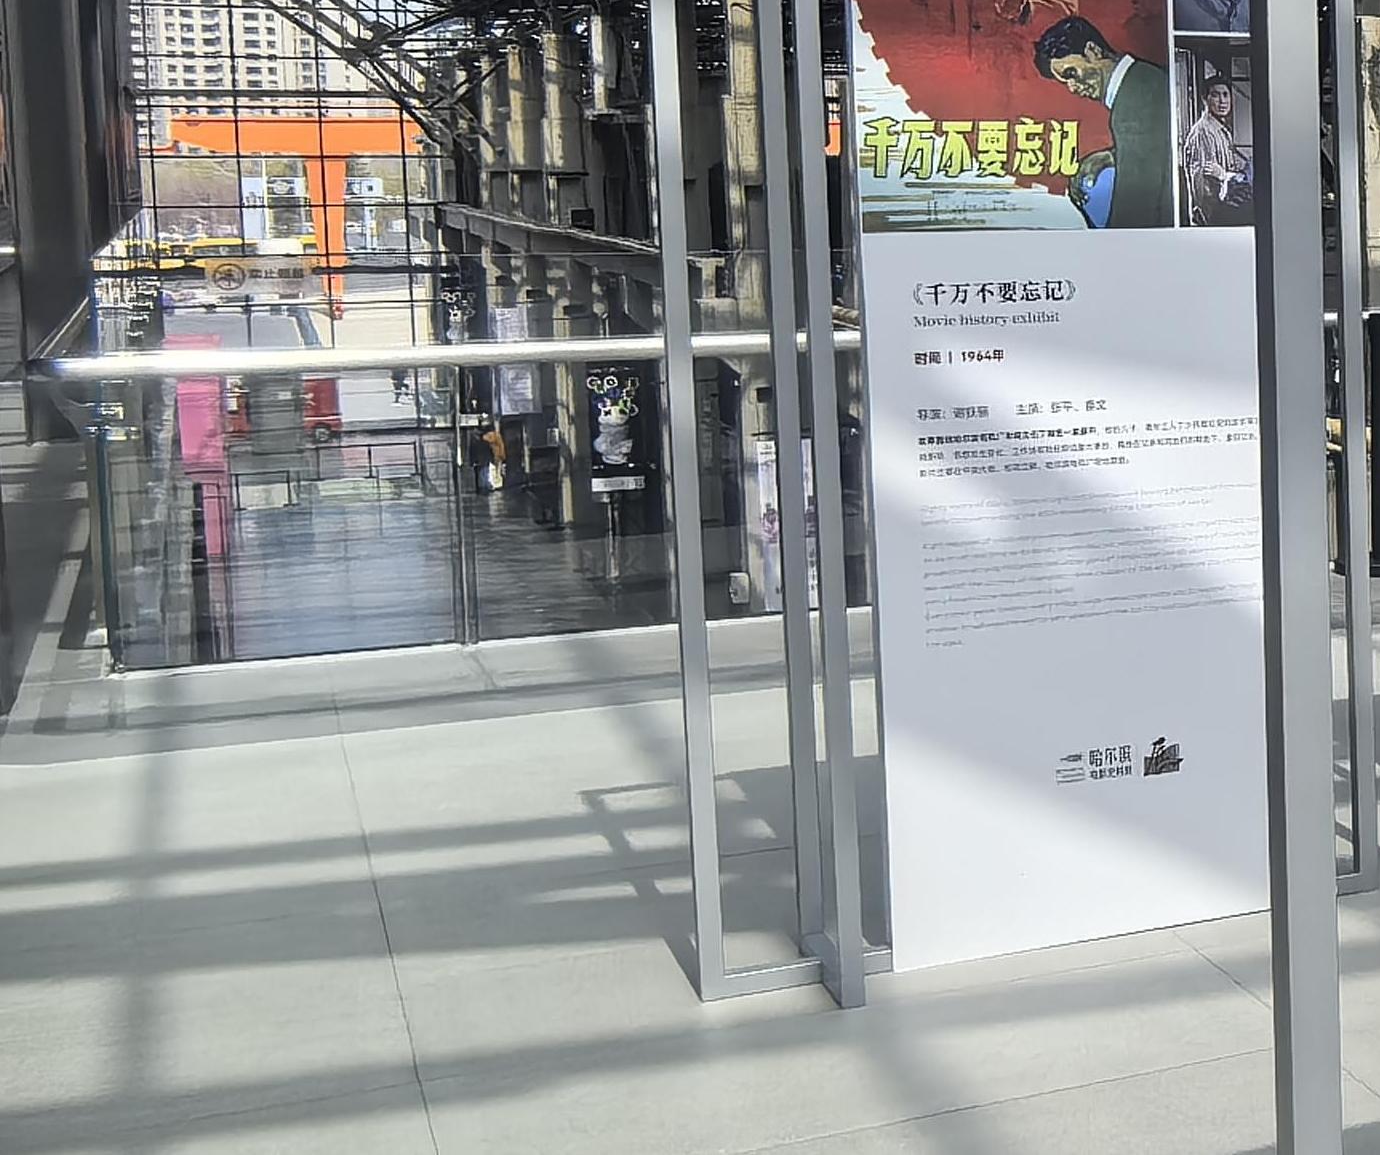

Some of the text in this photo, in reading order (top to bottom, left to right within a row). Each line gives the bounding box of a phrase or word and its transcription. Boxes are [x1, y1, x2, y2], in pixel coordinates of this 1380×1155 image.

[863, 116, 1080, 180] 千万不要忘记
[913, 279, 1077, 307] 《千万不要忘记》
[913, 310, 1061, 328] Movie history exhibit
[961, 349, 1005, 364] 1964年
